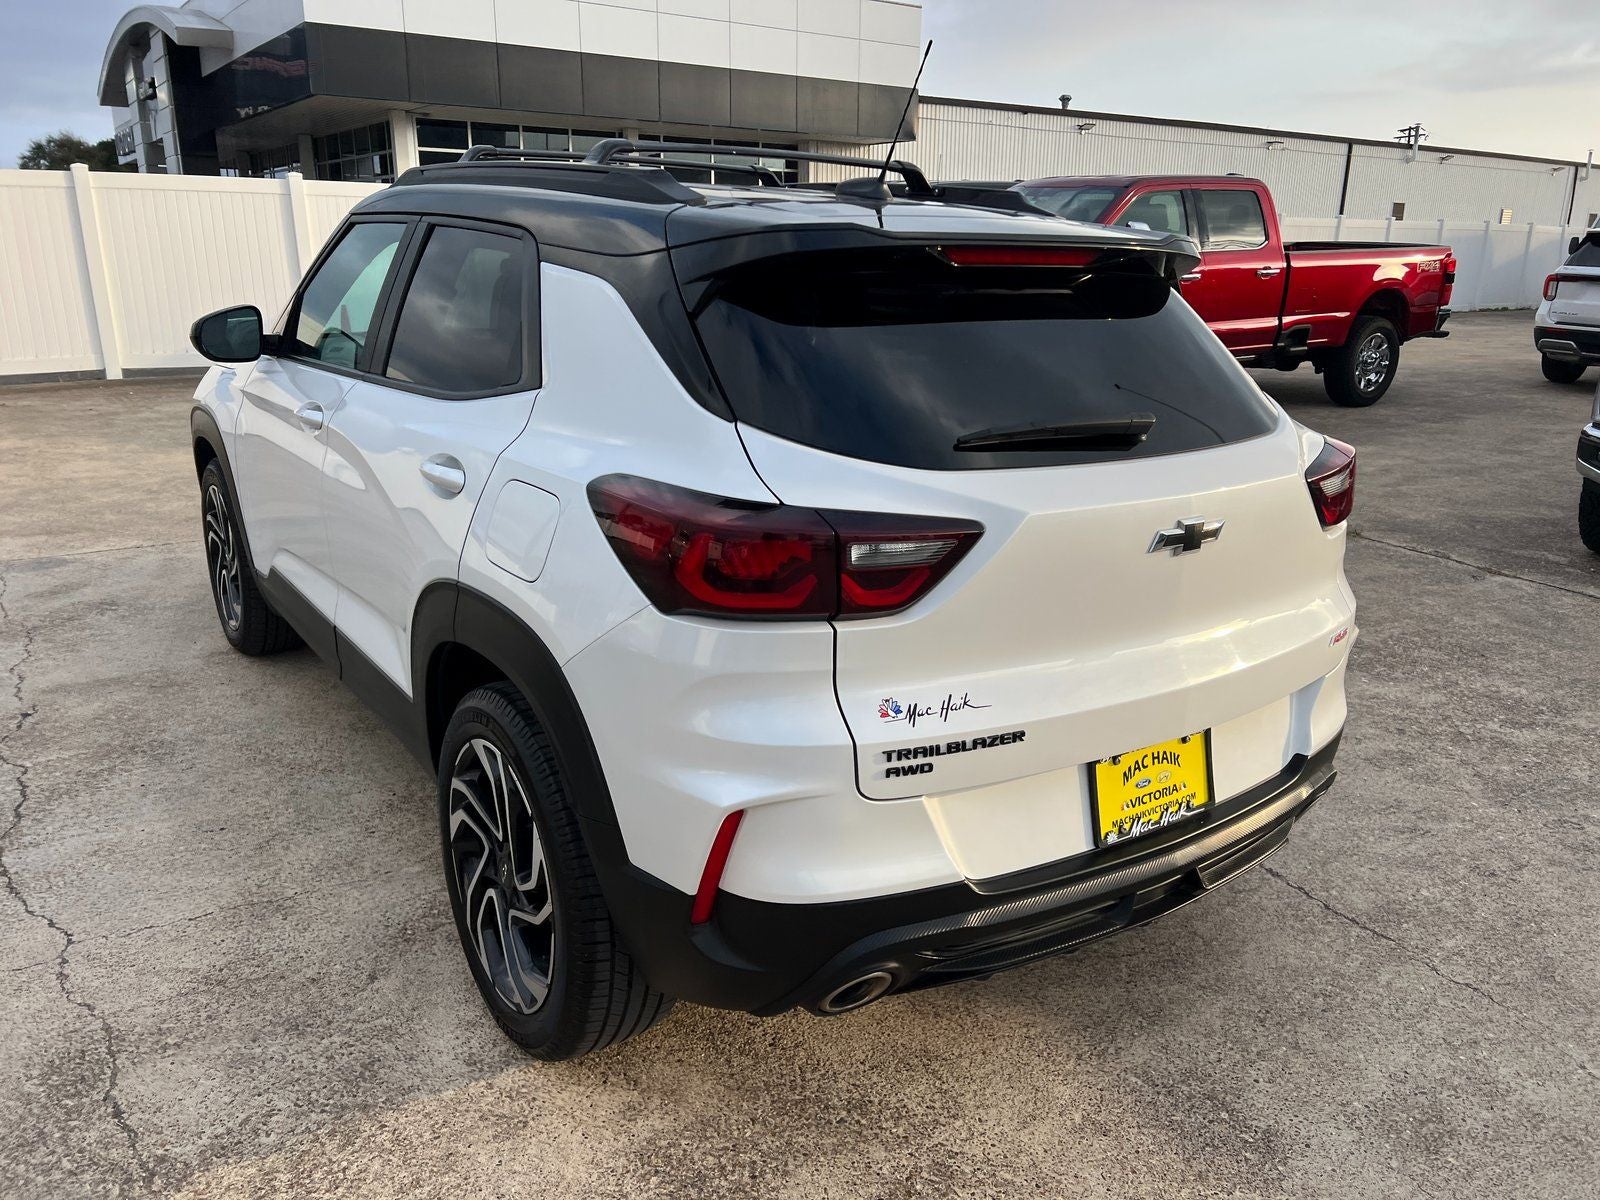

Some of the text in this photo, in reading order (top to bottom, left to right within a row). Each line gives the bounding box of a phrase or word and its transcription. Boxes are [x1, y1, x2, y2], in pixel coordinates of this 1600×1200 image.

[900, 692, 992, 728] Mac Haik
[882, 730, 1026, 763] TRAILBLAZER
[885, 762, 934, 778] AWD
[1122, 750, 1181, 786] MAC HAIK
[1129, 783, 1179, 809] VICTORIA
